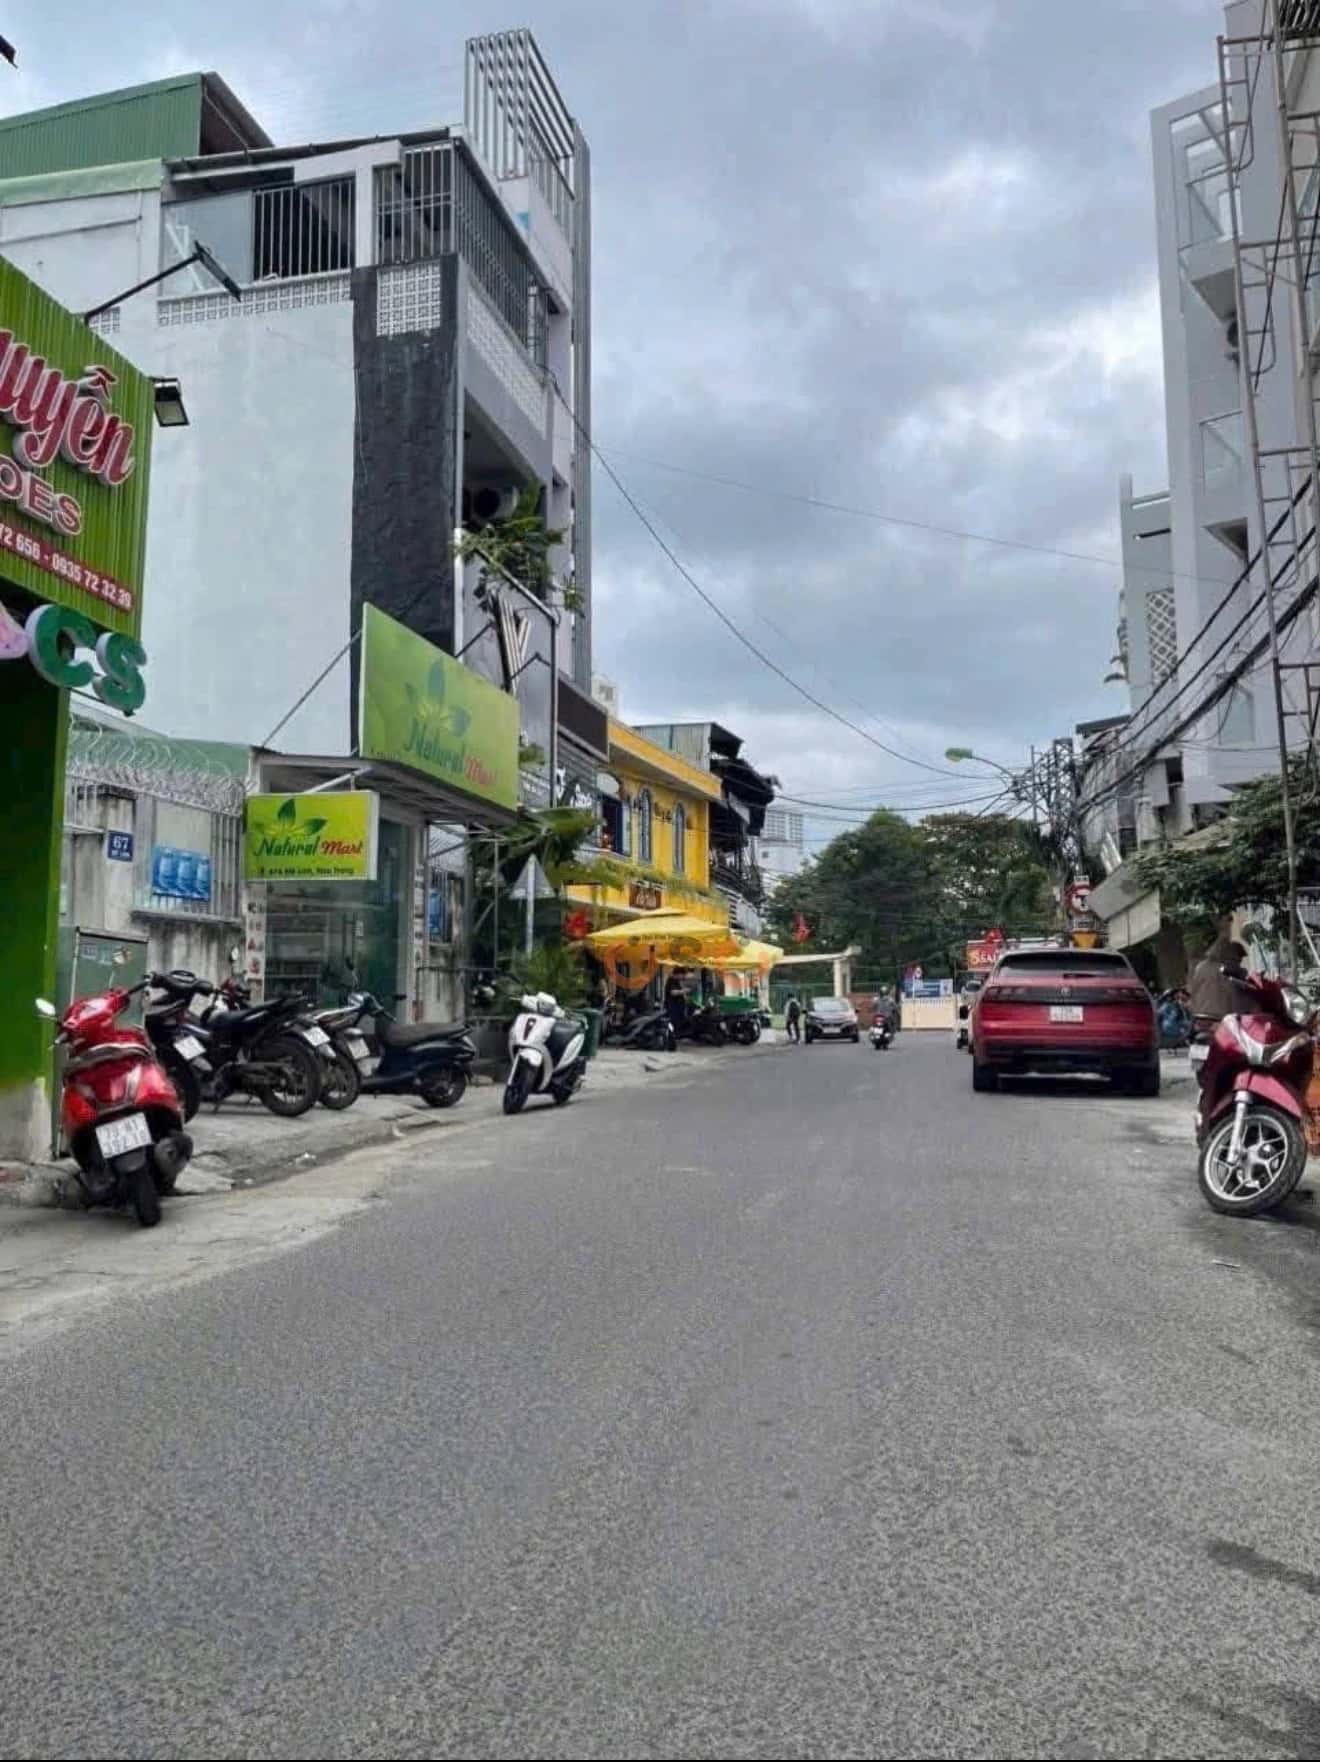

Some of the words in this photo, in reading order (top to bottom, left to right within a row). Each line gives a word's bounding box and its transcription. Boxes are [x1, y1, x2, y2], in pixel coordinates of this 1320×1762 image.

[403, 716, 466, 775] Natural
[113, 835, 129, 849] 67
[253, 836, 321, 857] Natural
[319, 840, 363, 855] Mart
